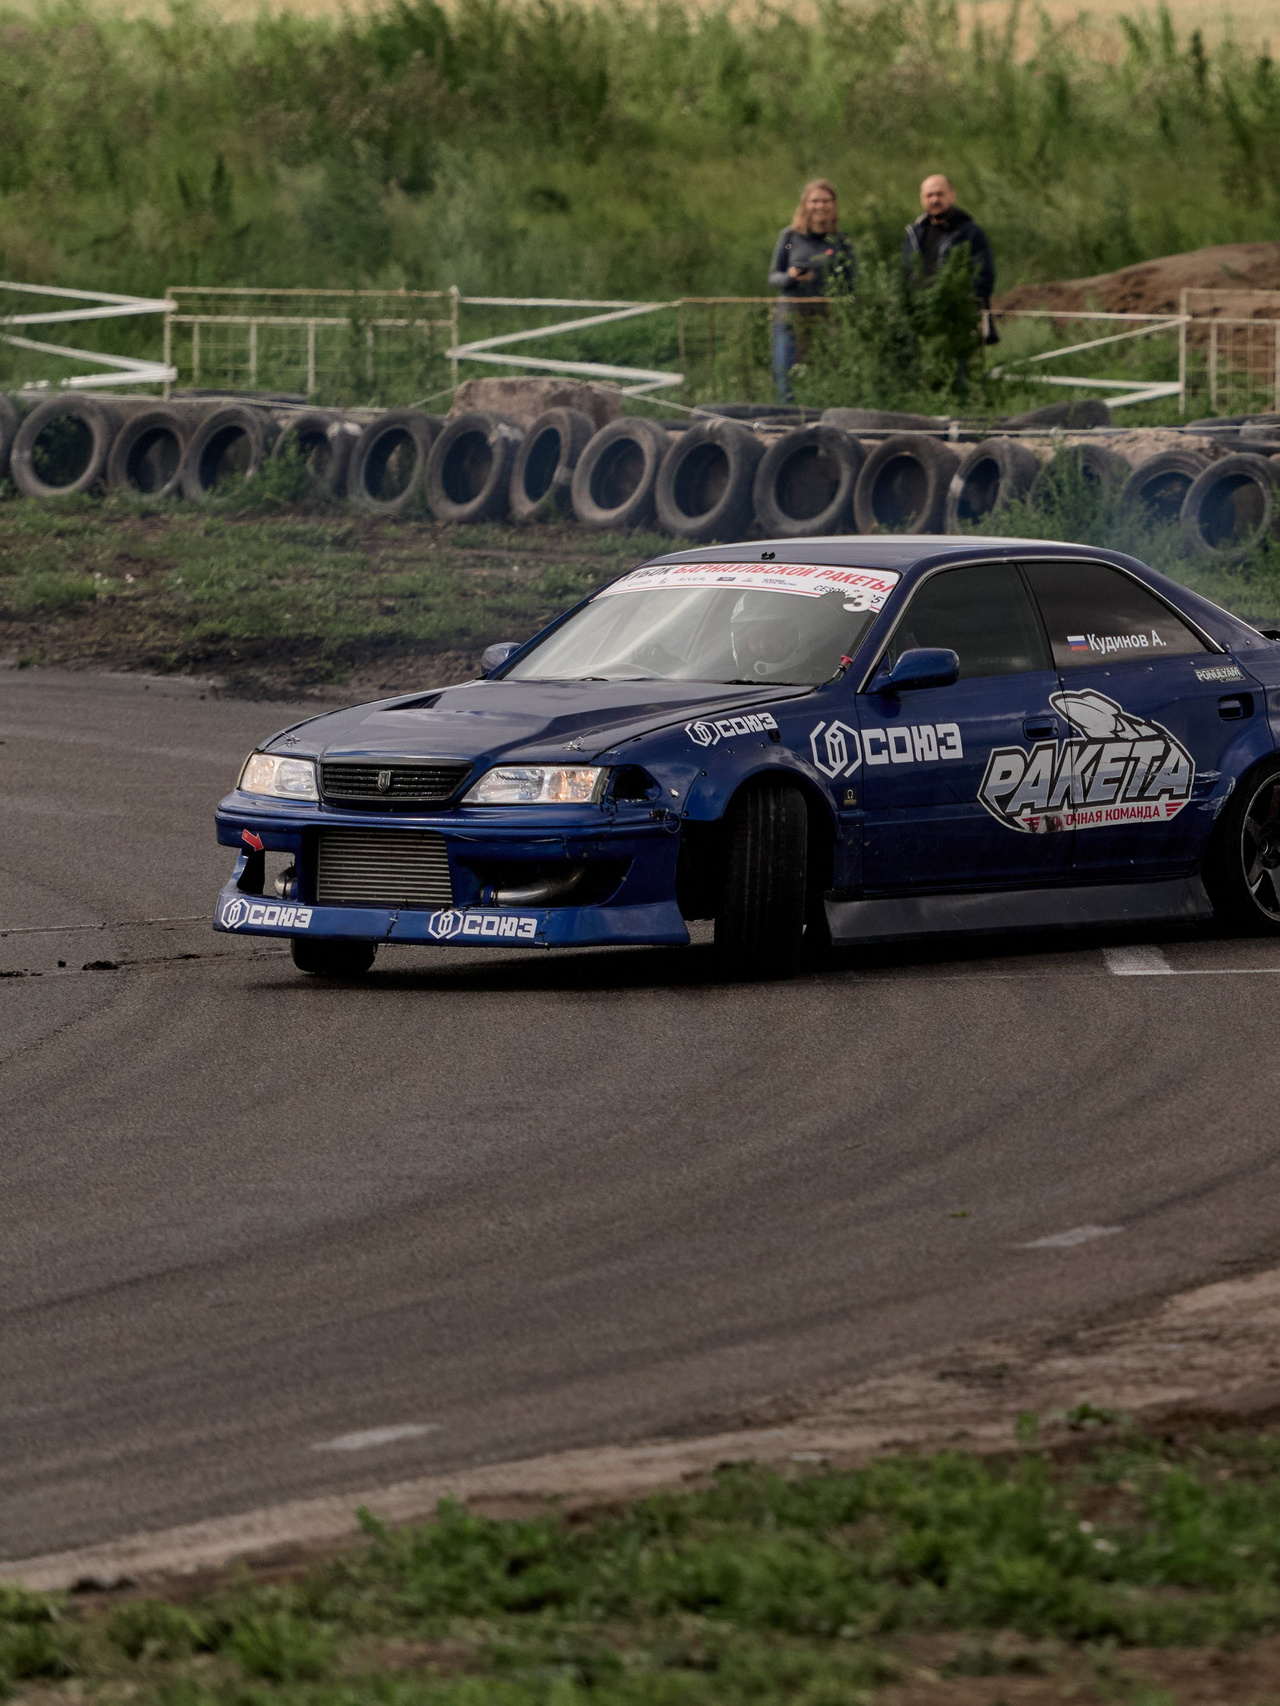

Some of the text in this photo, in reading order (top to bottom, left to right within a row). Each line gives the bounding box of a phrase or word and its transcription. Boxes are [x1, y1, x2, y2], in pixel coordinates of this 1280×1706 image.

[673, 564, 818, 577] БАРНАУЛЬСКОЙ
[814, 568, 896, 592] РАКЕТЫ
[1086, 629, 1167, 655] Кудинов А.
[714, 712, 778, 738] СОЮЗ
[861, 722, 963, 765] СОЮЗ
[984, 740, 1190, 816] РАКЕТА
[1045, 805, 1160, 830] ОЧНАЯ КОМАНДА
[248, 905, 312, 928] СОЮЗ
[463, 915, 538, 938] СОЮЗ
